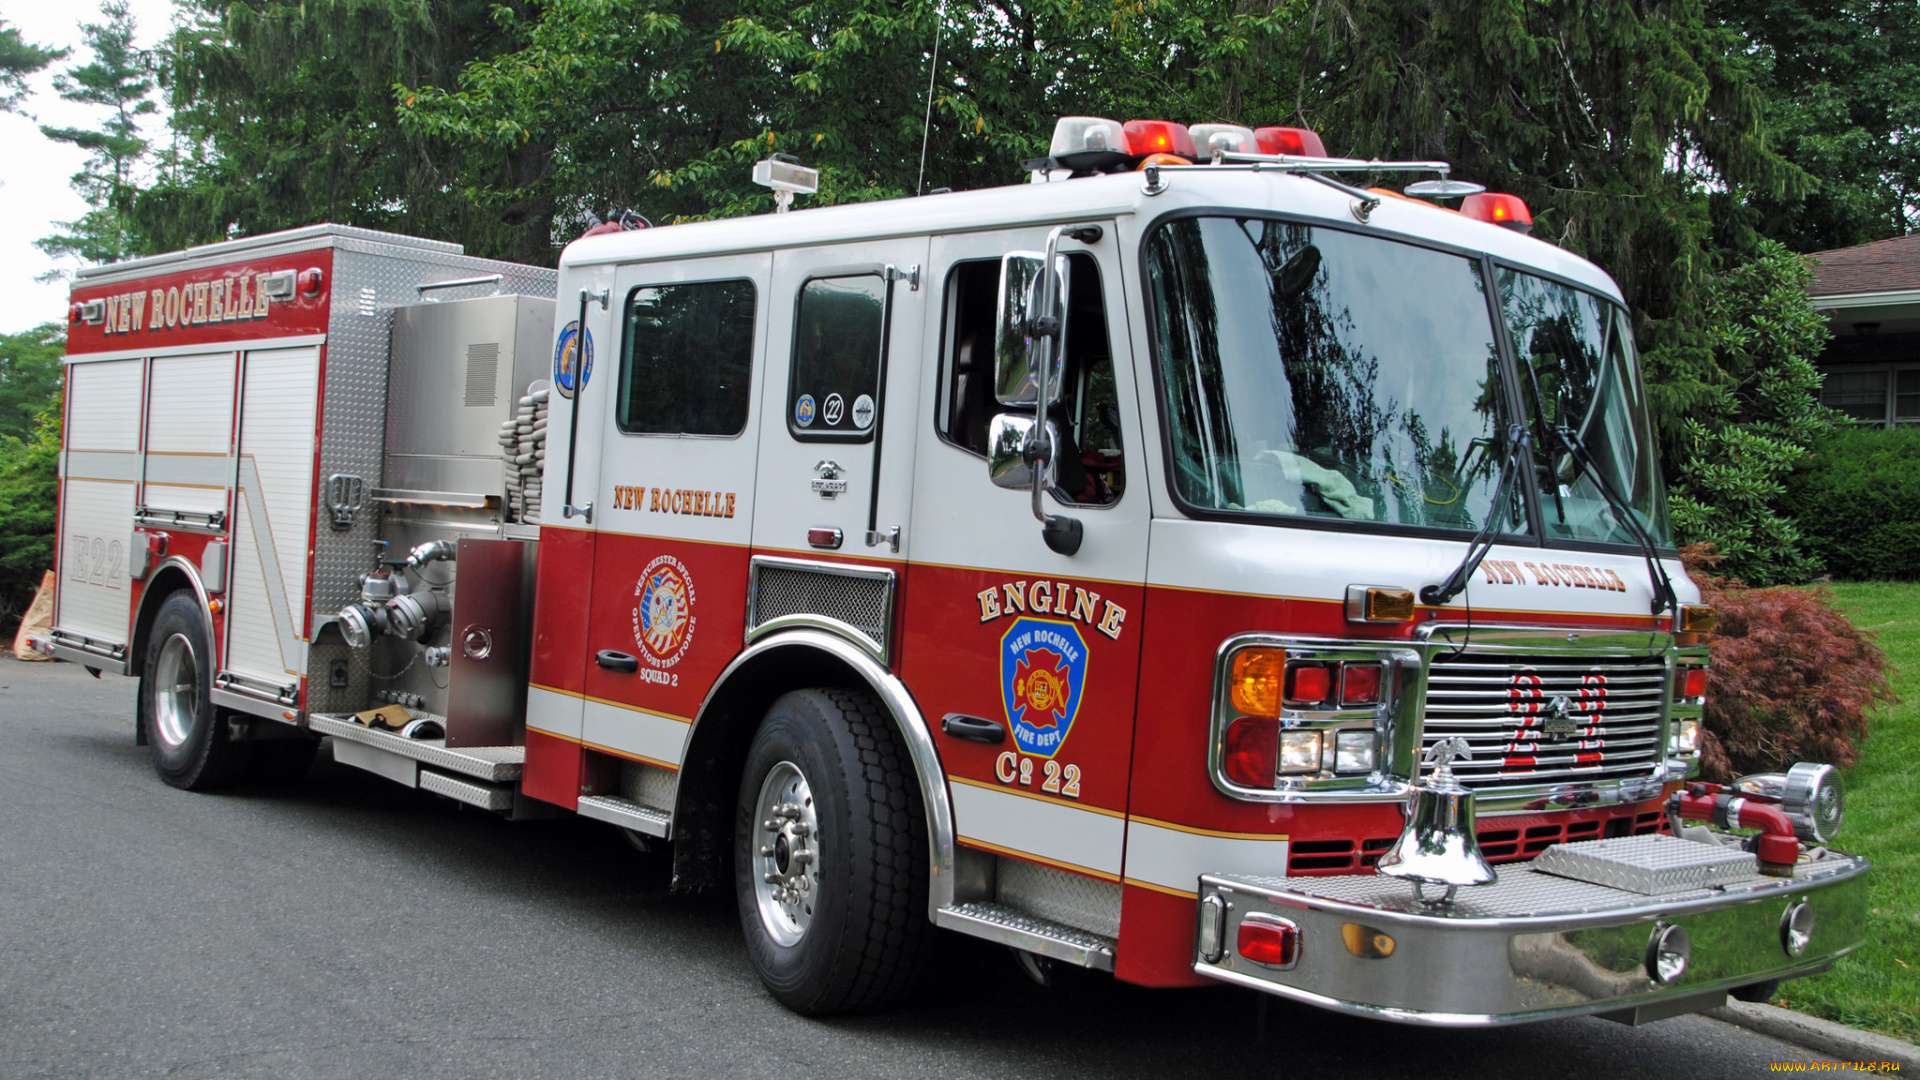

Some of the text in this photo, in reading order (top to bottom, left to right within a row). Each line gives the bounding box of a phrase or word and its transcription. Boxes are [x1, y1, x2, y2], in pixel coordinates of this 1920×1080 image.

[104, 272, 271, 334] NEW ROCHELLE
[826, 399, 841, 419] 22
[613, 485, 736, 519] NEW ROCHELLE
[71, 535, 123, 590] E22
[634, 555, 697, 605] WESTCHESTER SPECIAL
[1479, 560, 1626, 592] NEW ROCHELLE
[977, 580, 1126, 641] ENGINE
[632, 607, 697, 669] OPERATIONS TASK FORCE
[1009, 629, 1079, 663] NEW ROCHELLE
[640, 667, 678, 687] SQUAD 2
[1014, 723, 1061, 747] FIRE DEPT
[1041, 760, 1081, 798] 22
